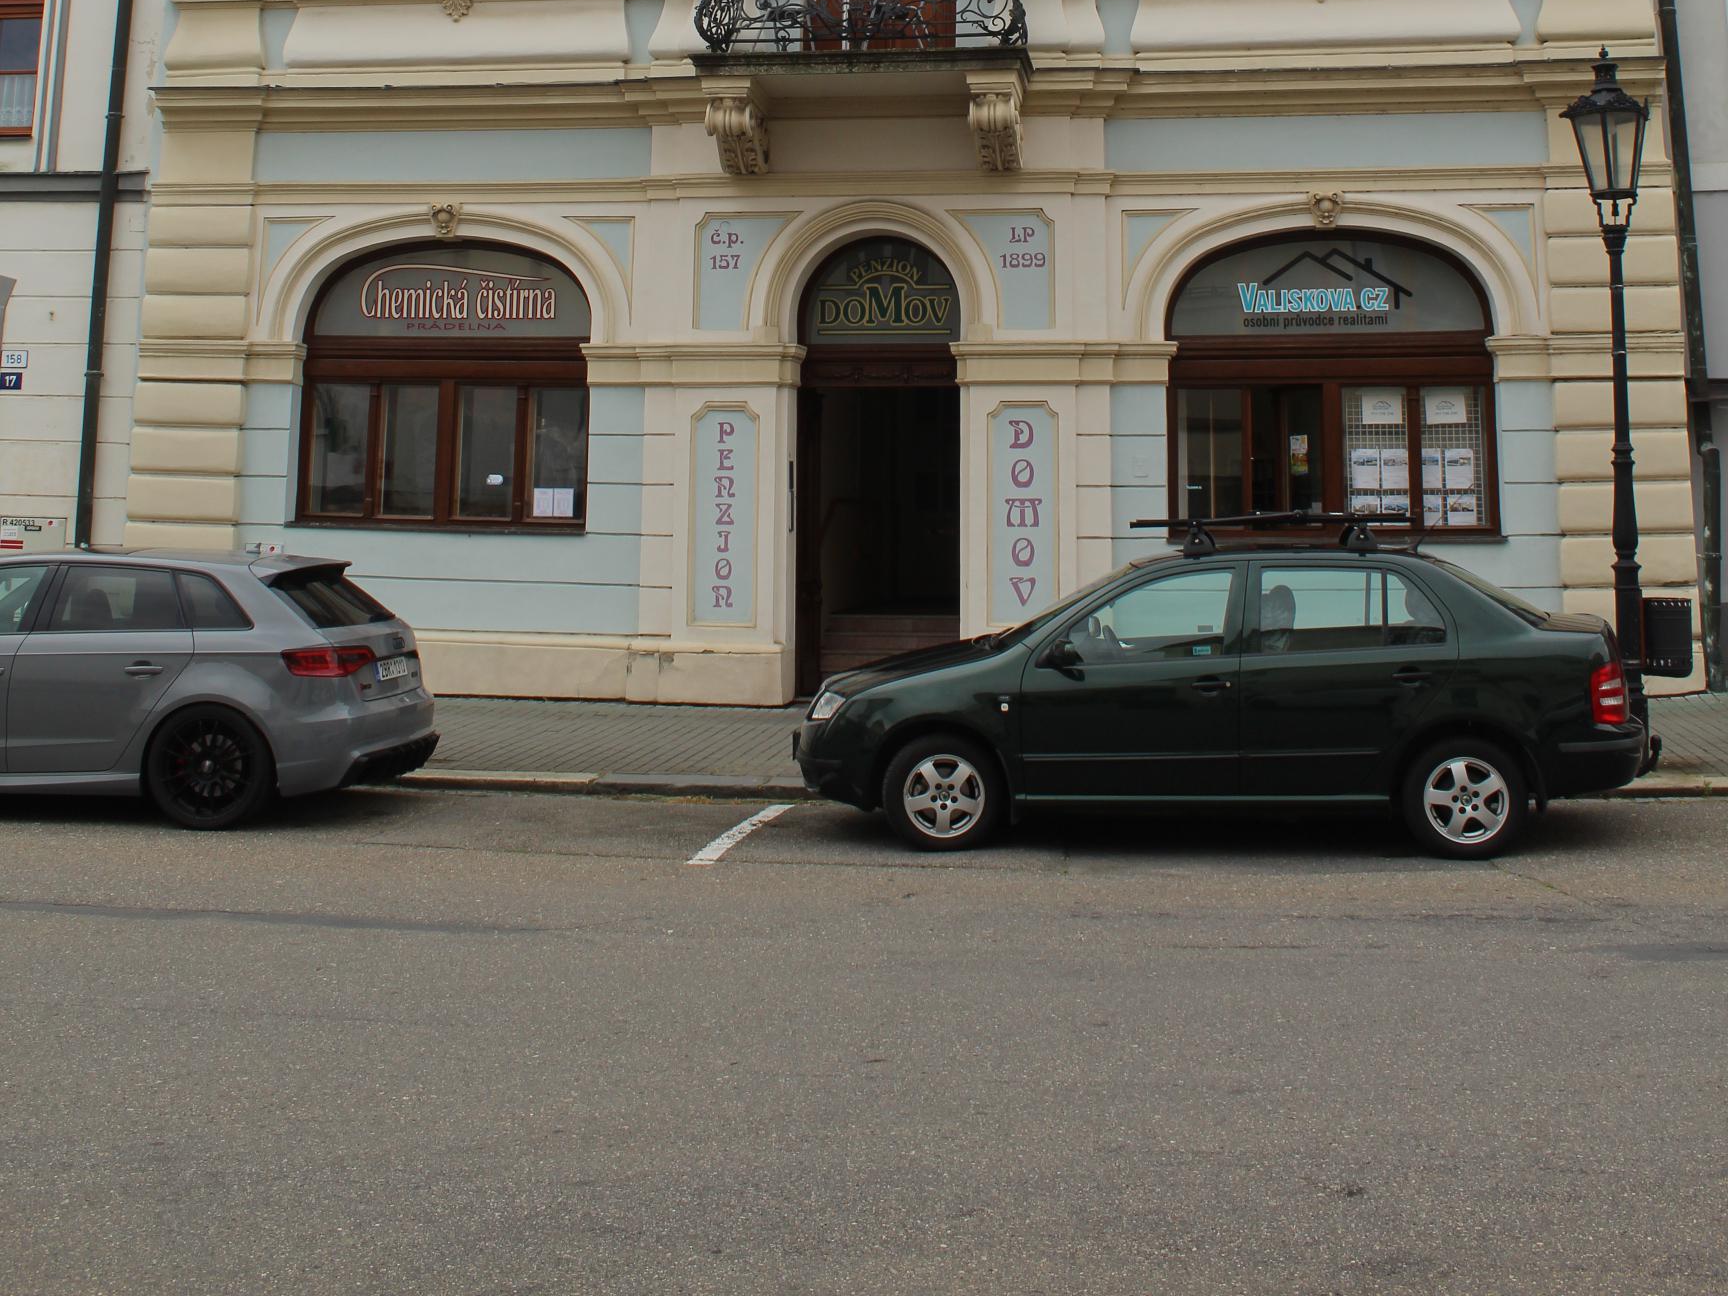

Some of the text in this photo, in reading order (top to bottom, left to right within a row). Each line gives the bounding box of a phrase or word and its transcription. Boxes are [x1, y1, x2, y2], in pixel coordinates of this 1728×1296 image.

[710, 228, 744, 249] č.p.
[1008, 226, 1036, 244] LP
[709, 254, 741, 270] 157
[999, 251, 1046, 269] 1899
[849, 258, 922, 283] PENZION
[361, 278, 557, 320] Chemická čistírna
[406, 320, 507, 331] PRÁDELNA
[1283, 313, 1335, 329] průvodce
[1338, 312, 1389, 326] realitami
[6, 354, 22, 364] 158
[5, 375, 17, 387] 17
[1004, 419, 1043, 608] DOMOV
